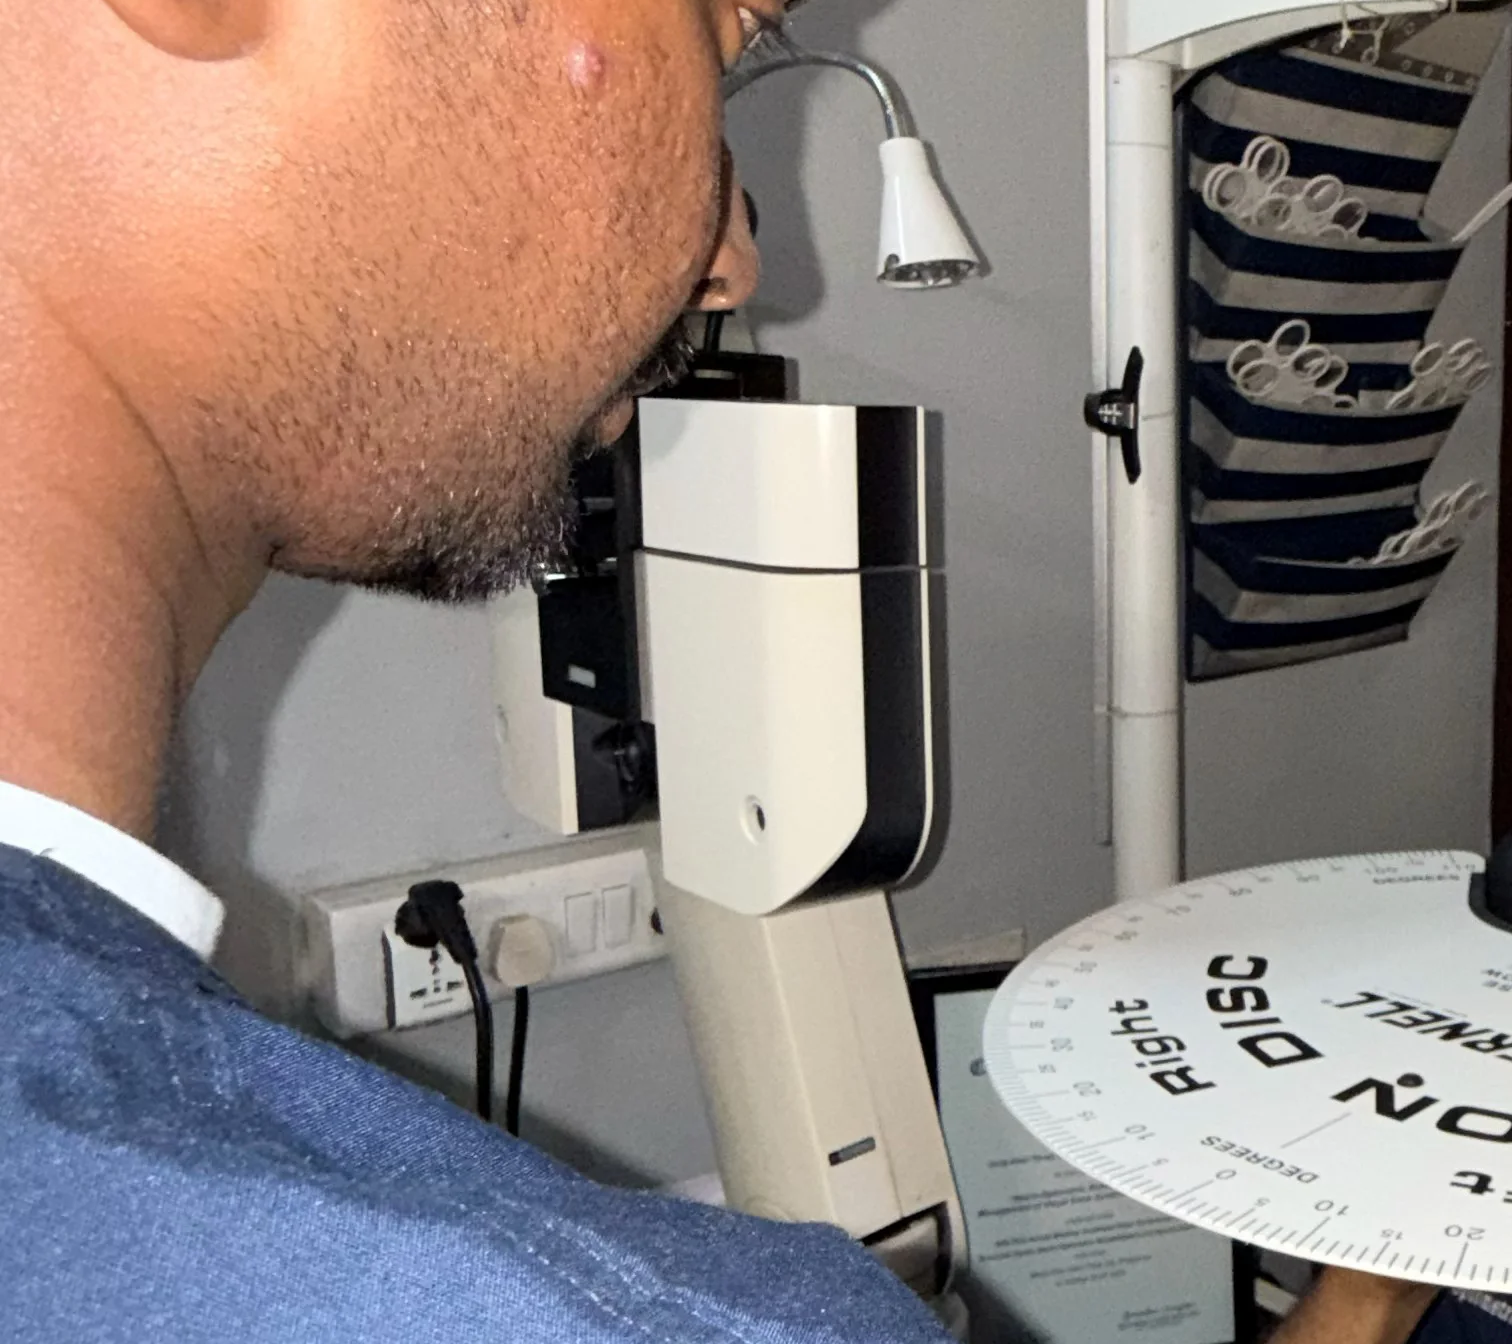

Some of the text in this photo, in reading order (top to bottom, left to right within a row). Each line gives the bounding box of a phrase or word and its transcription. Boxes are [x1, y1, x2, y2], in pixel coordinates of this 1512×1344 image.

[1205, 954, 1325, 1068] DISC
[1108, 998, 1217, 1095] Right
[1124, 1123, 1156, 1142] 10
[1200, 1134, 1320, 1185] DEGREES
[1215, 1168, 1238, 1181] 0
[1313, 1199, 1351, 1217] 10
[1444, 1223, 1487, 1241] 20
